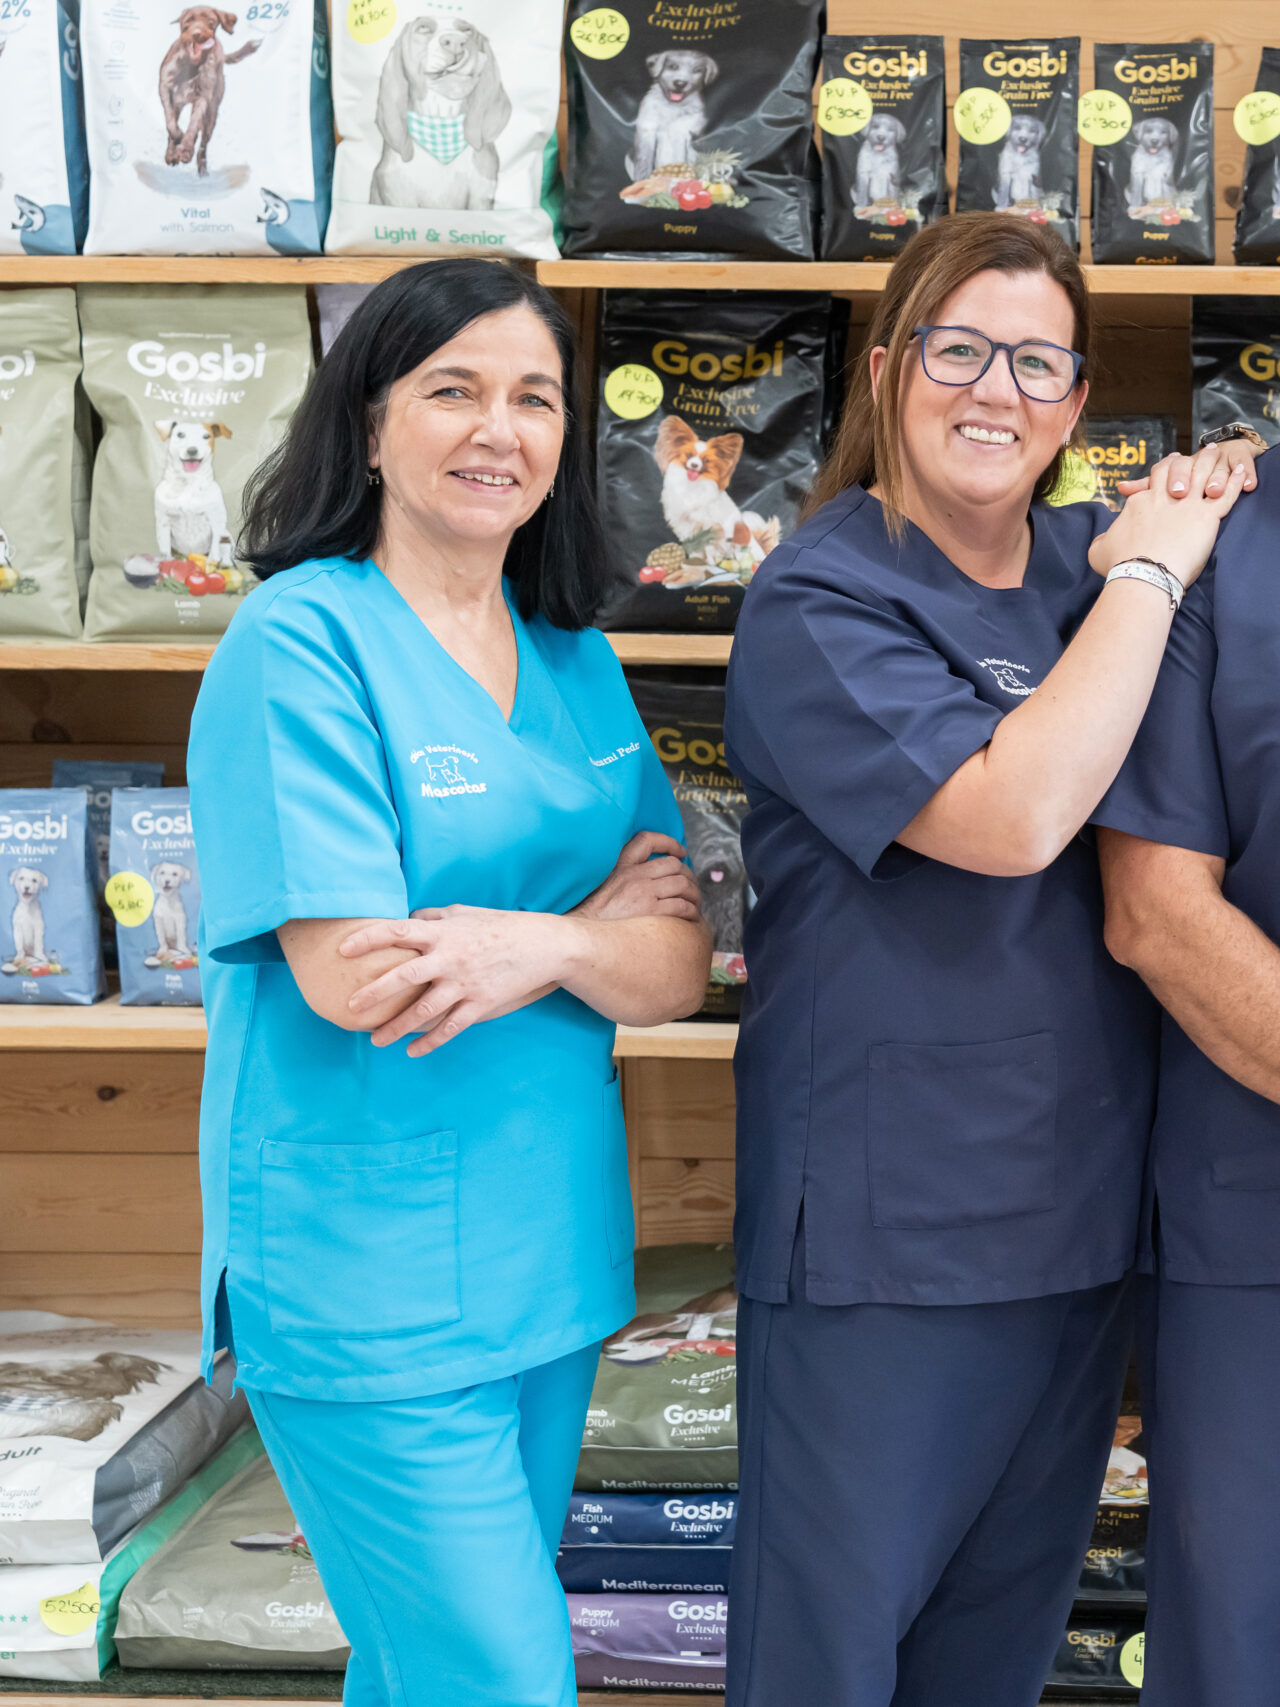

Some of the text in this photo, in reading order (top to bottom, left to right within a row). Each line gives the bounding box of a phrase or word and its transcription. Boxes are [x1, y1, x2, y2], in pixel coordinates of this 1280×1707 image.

[246, 1, 290, 20] 82%
[655, 1, 738, 17] Exclusive
[647, 14, 741, 31] Grain Free
[843, 50, 928, 78] Gosbi
[983, 50, 1067, 78] Gosbi
[1113, 57, 1198, 84] Gosbi
[1001, 80, 1051, 90] Exclusive
[1132, 85, 1181, 96] Exclusive
[181, 207, 210, 219] Vital
[160, 223, 234, 232] with Salmon
[663, 222, 698, 235] Puppy
[374, 225, 506, 246] Light & Senior
[869, 230, 896, 242] Puppy
[1142, 231, 1171, 242] Puppy
[127, 340, 267, 382] Gosbi
[652, 340, 784, 381] Gosbi
[144, 381, 246, 406] Exclusive
[678, 382, 756, 403] Exclusive
[672, 397, 761, 417] Grain Free
[175, 600, 200, 608] Lamb
[421, 782, 488, 798] Mascotas
[0, 814, 68, 840] Gosbi
[664, 1404, 732, 1425] Gosbi
[670, 1424, 721, 1437] Exclusive
[601, 1479, 724, 1490] Mediterranean
[583, 1503, 603, 1514] Fish
[663, 1499, 735, 1520] Gosbi
[1109, 1510, 1140, 1519] Fish
[571, 1513, 613, 1524] MEDIUM
[670, 1521, 723, 1533] Exclusive
[1085, 1546, 1123, 1559] osbi
[602, 1579, 724, 1592] Mediterranean
[265, 1601, 325, 1618] Gosbi
[581, 1607, 614, 1619] Puppy
[269, 1619, 314, 1629] Exclusive
[572, 1617, 620, 1628] MEDIUM
[1067, 1631, 1116, 1647] Gosbi
